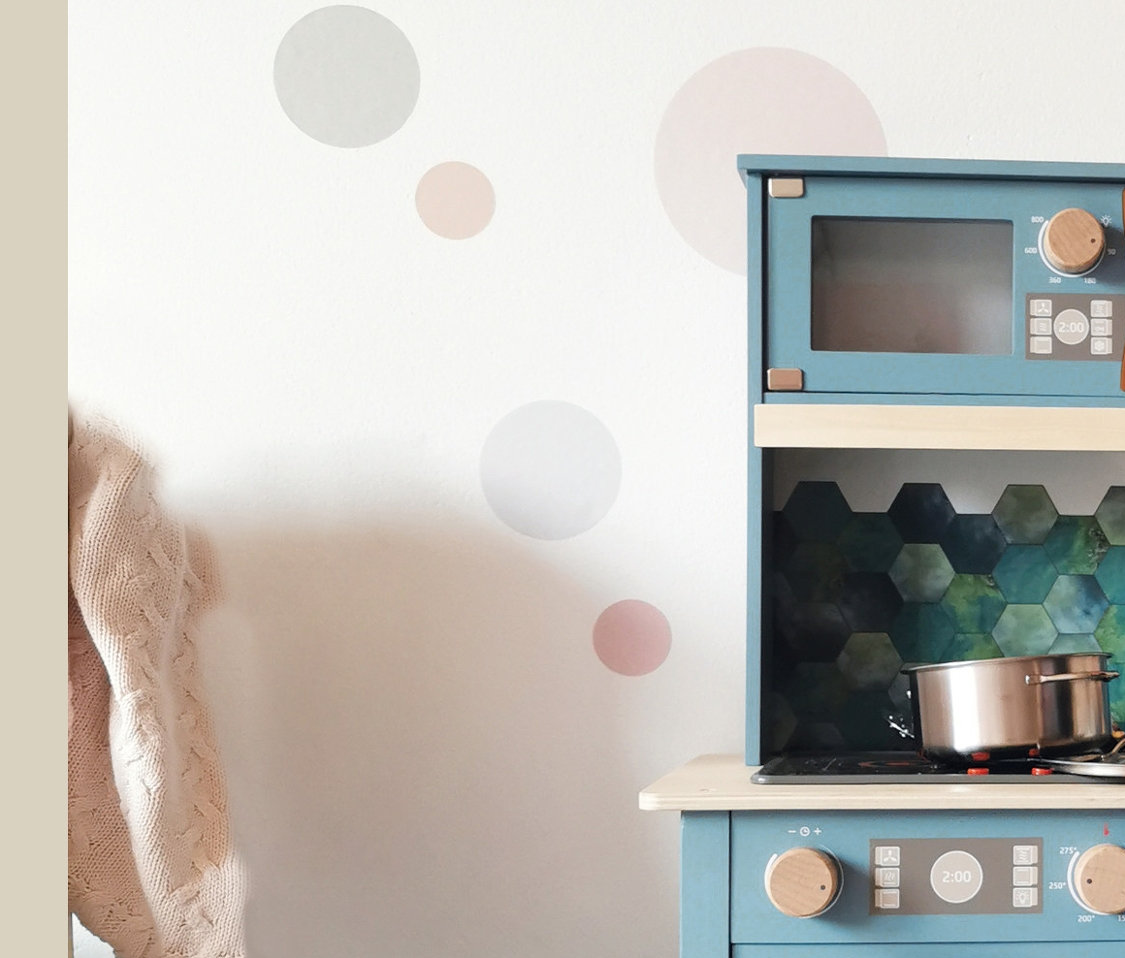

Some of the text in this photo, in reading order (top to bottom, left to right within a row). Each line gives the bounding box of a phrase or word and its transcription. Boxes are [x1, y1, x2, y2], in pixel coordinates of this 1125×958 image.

[1058, 322, 1085, 333] 2:00
[1059, 847, 1077, 855] 275°
[942, 870, 972, 883] 2:00
[1048, 882, 1066, 890] 250°
[1077, 915, 1095, 923] 200°
